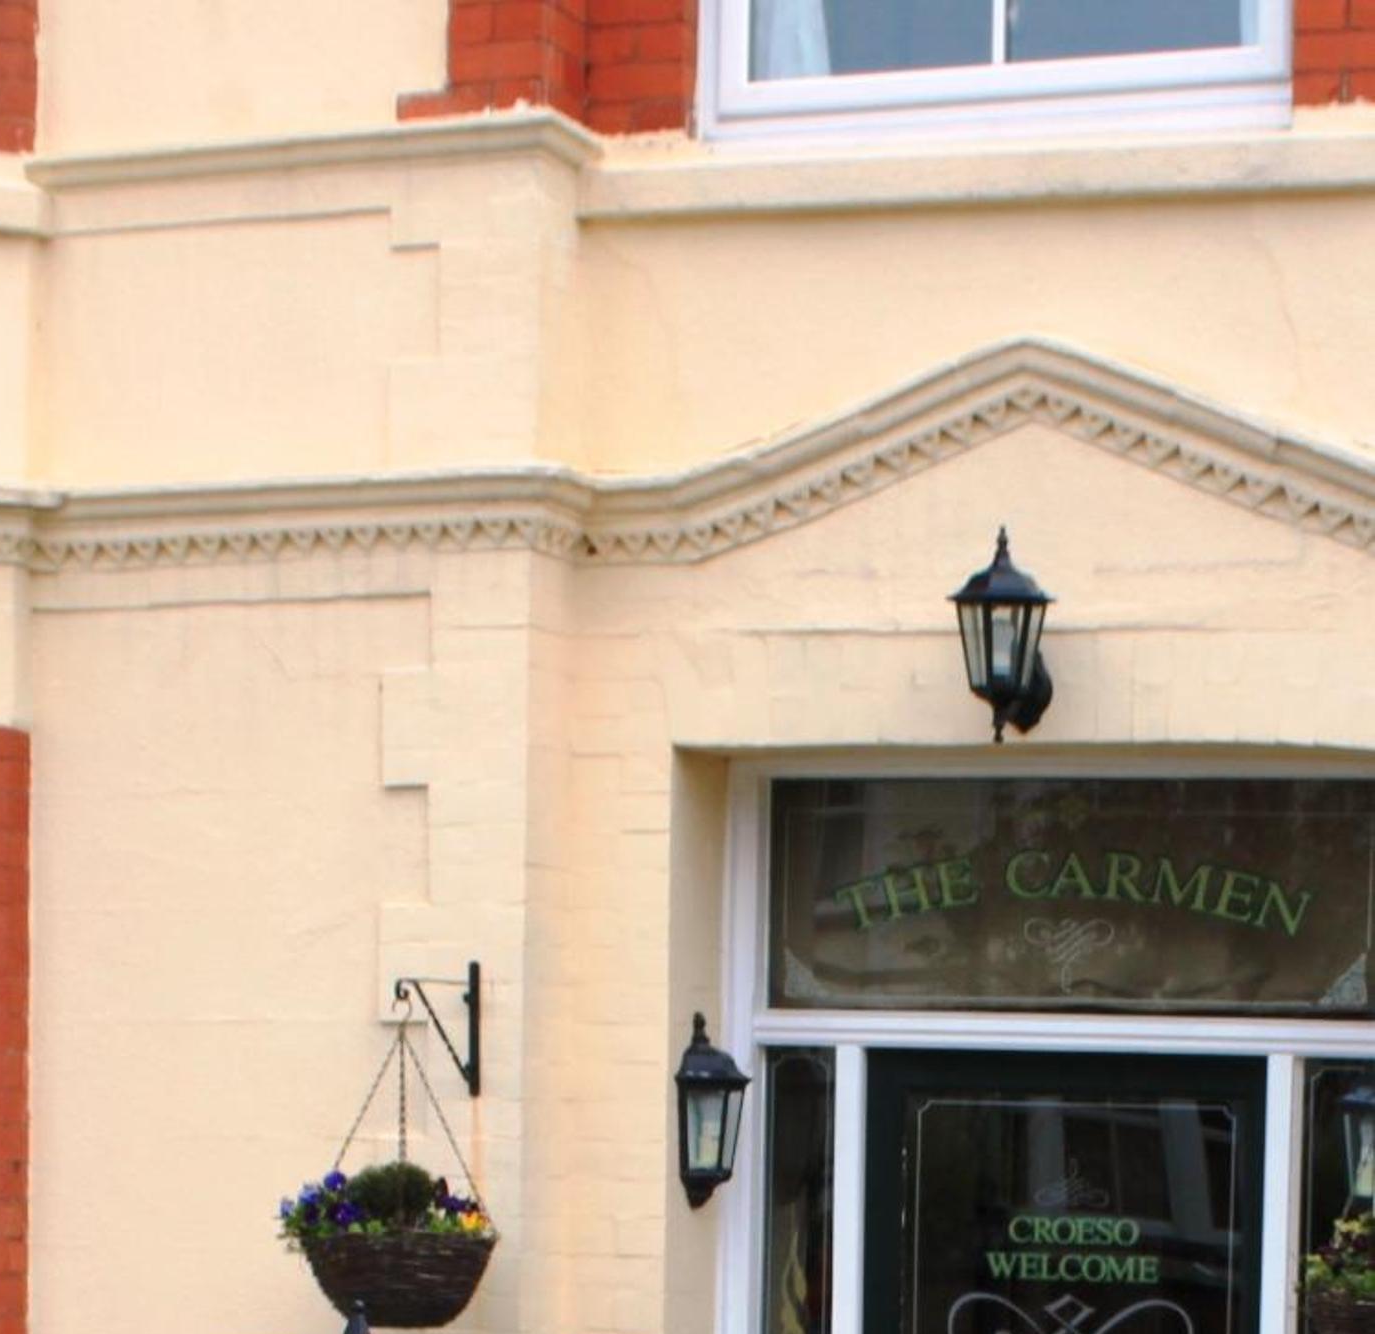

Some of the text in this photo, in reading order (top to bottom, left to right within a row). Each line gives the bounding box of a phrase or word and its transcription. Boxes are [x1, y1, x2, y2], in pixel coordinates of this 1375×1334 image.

[836, 852, 1312, 937] THE CARMEN
[1008, 1216, 1140, 1246] CROESO
[986, 1252, 1160, 1284] WELCOME
